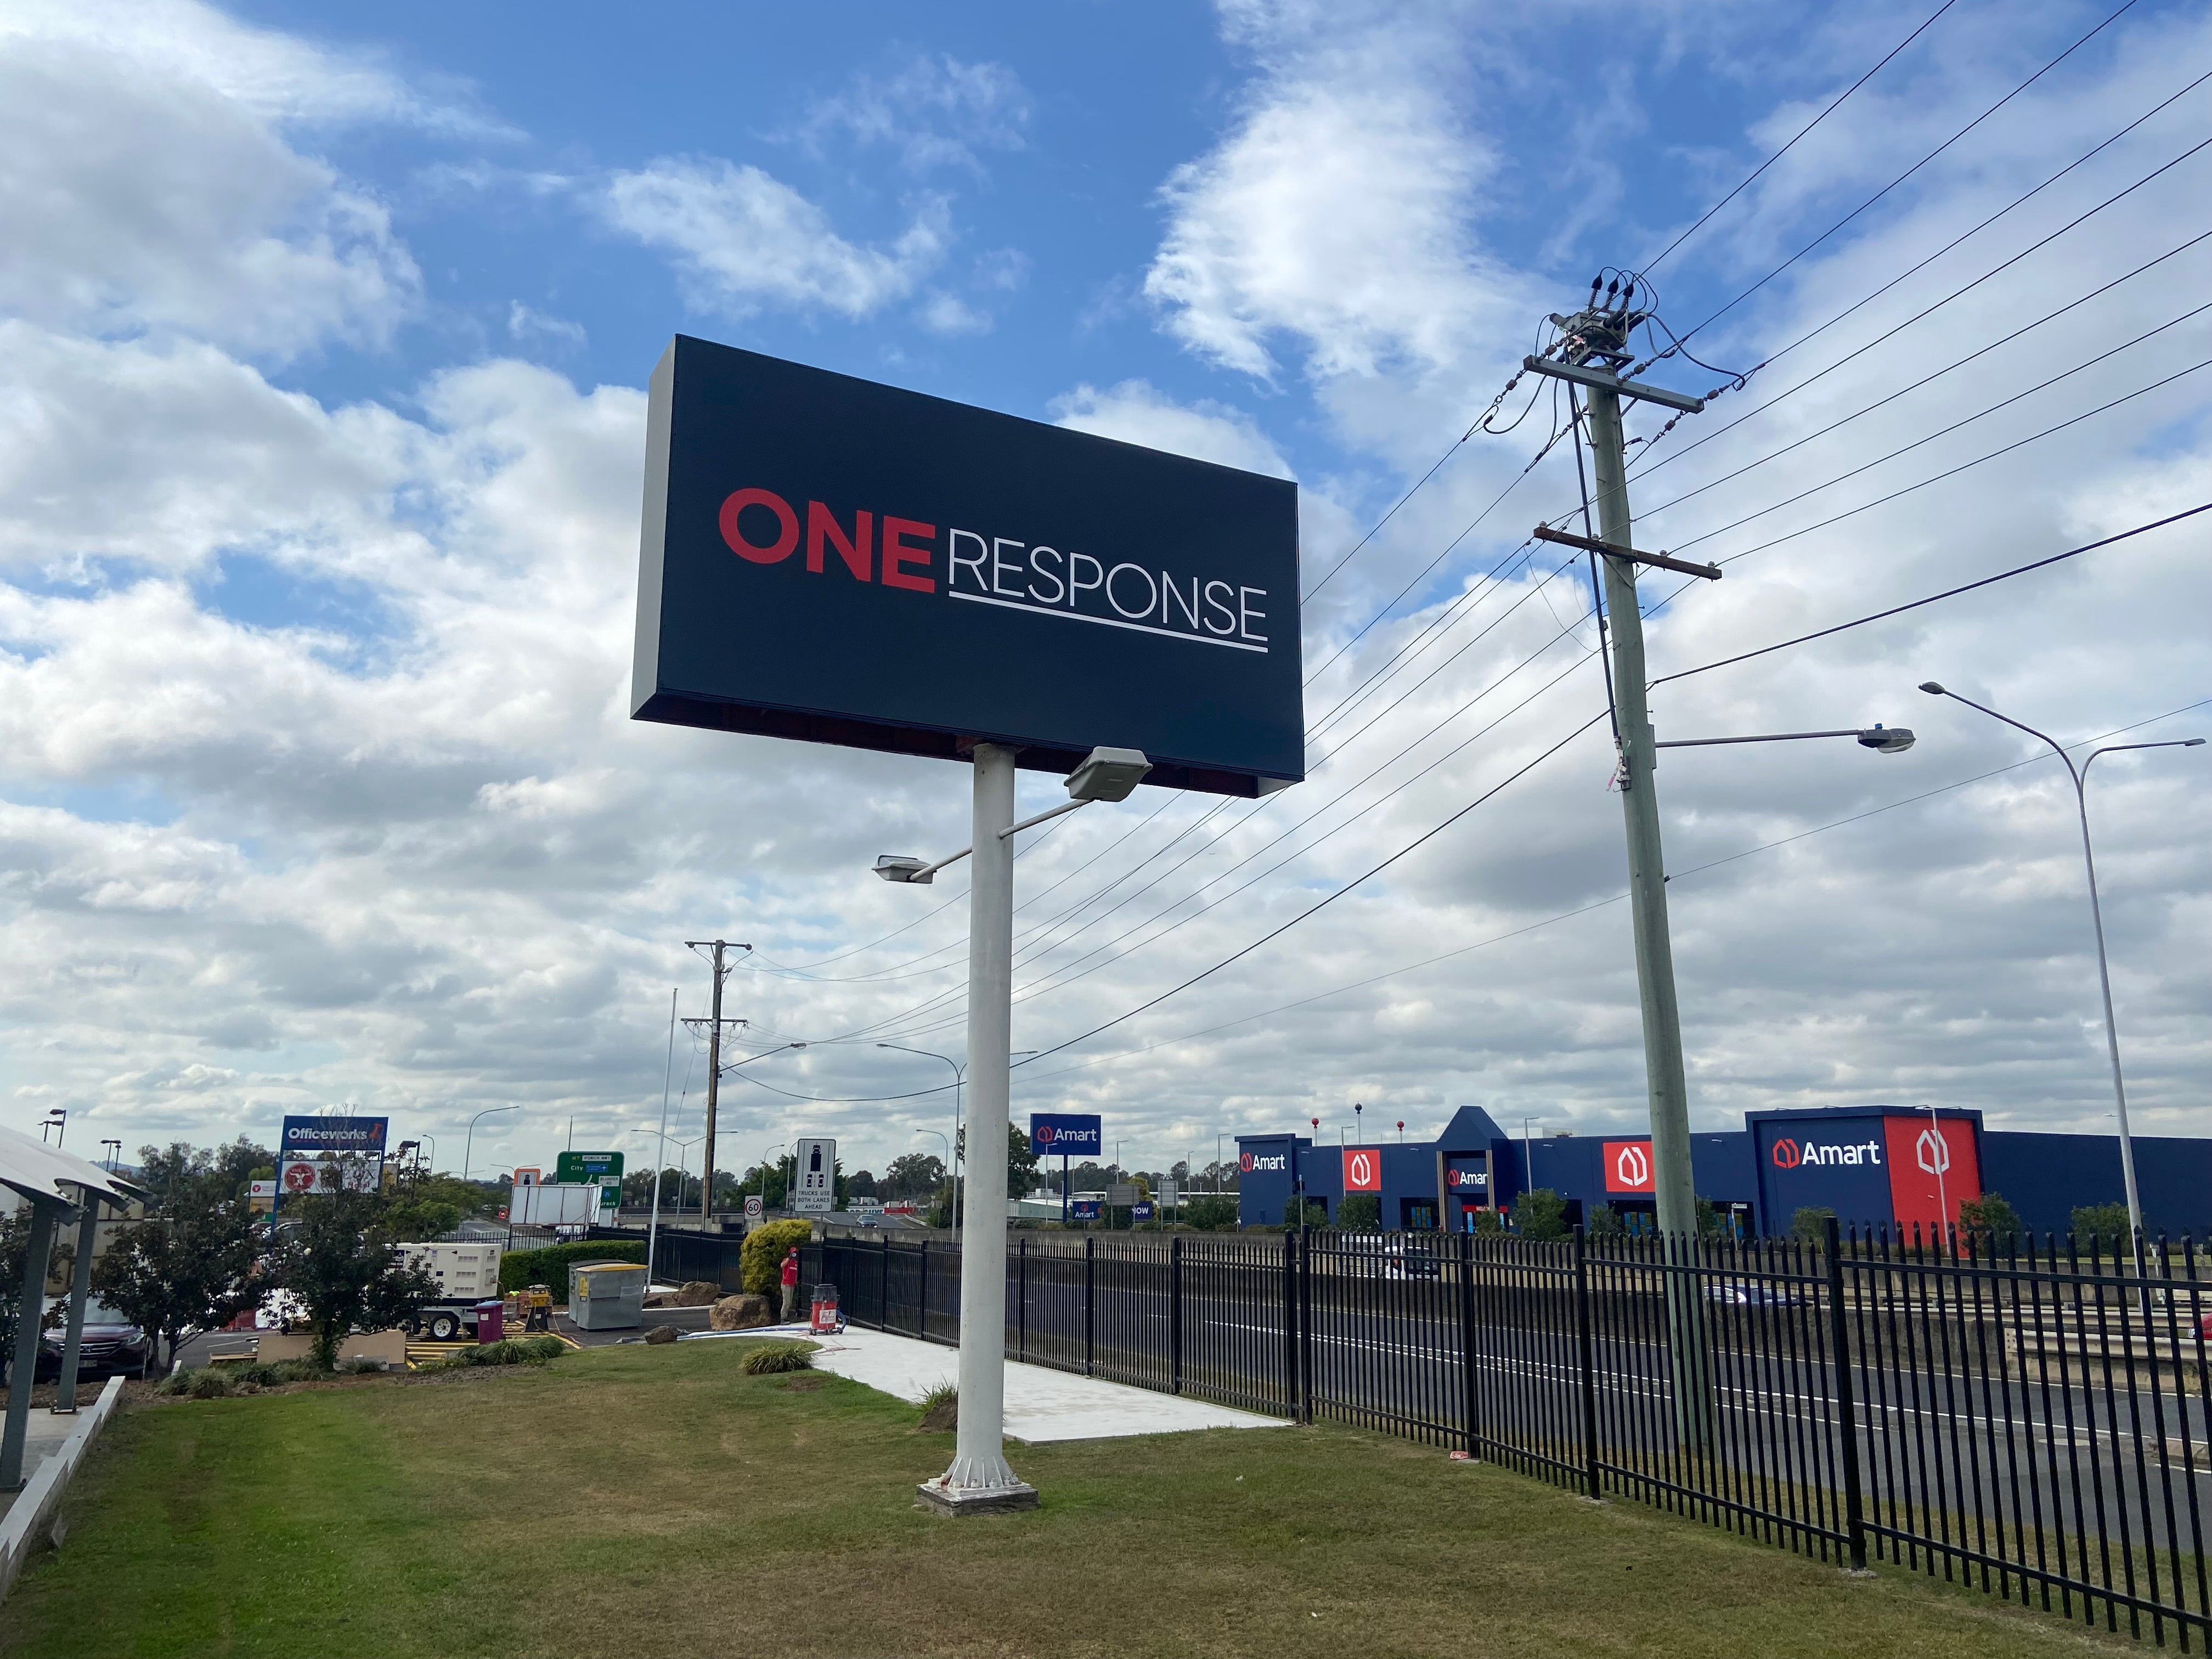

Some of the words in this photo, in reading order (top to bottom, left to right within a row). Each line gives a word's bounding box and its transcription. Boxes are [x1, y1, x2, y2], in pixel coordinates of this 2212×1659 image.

[719, 487, 936, 594] ONE
[949, 528, 1268, 641] RESPONSE
[288, 1127, 368, 1140] Officeworks
[1054, 1128, 1097, 1141] Amart
[1802, 1140, 1881, 1165] Amart
[1252, 1154, 1285, 1170] Amart
[1459, 1171, 1488, 1184] Amar
[748, 1203, 759, 1211] 60
